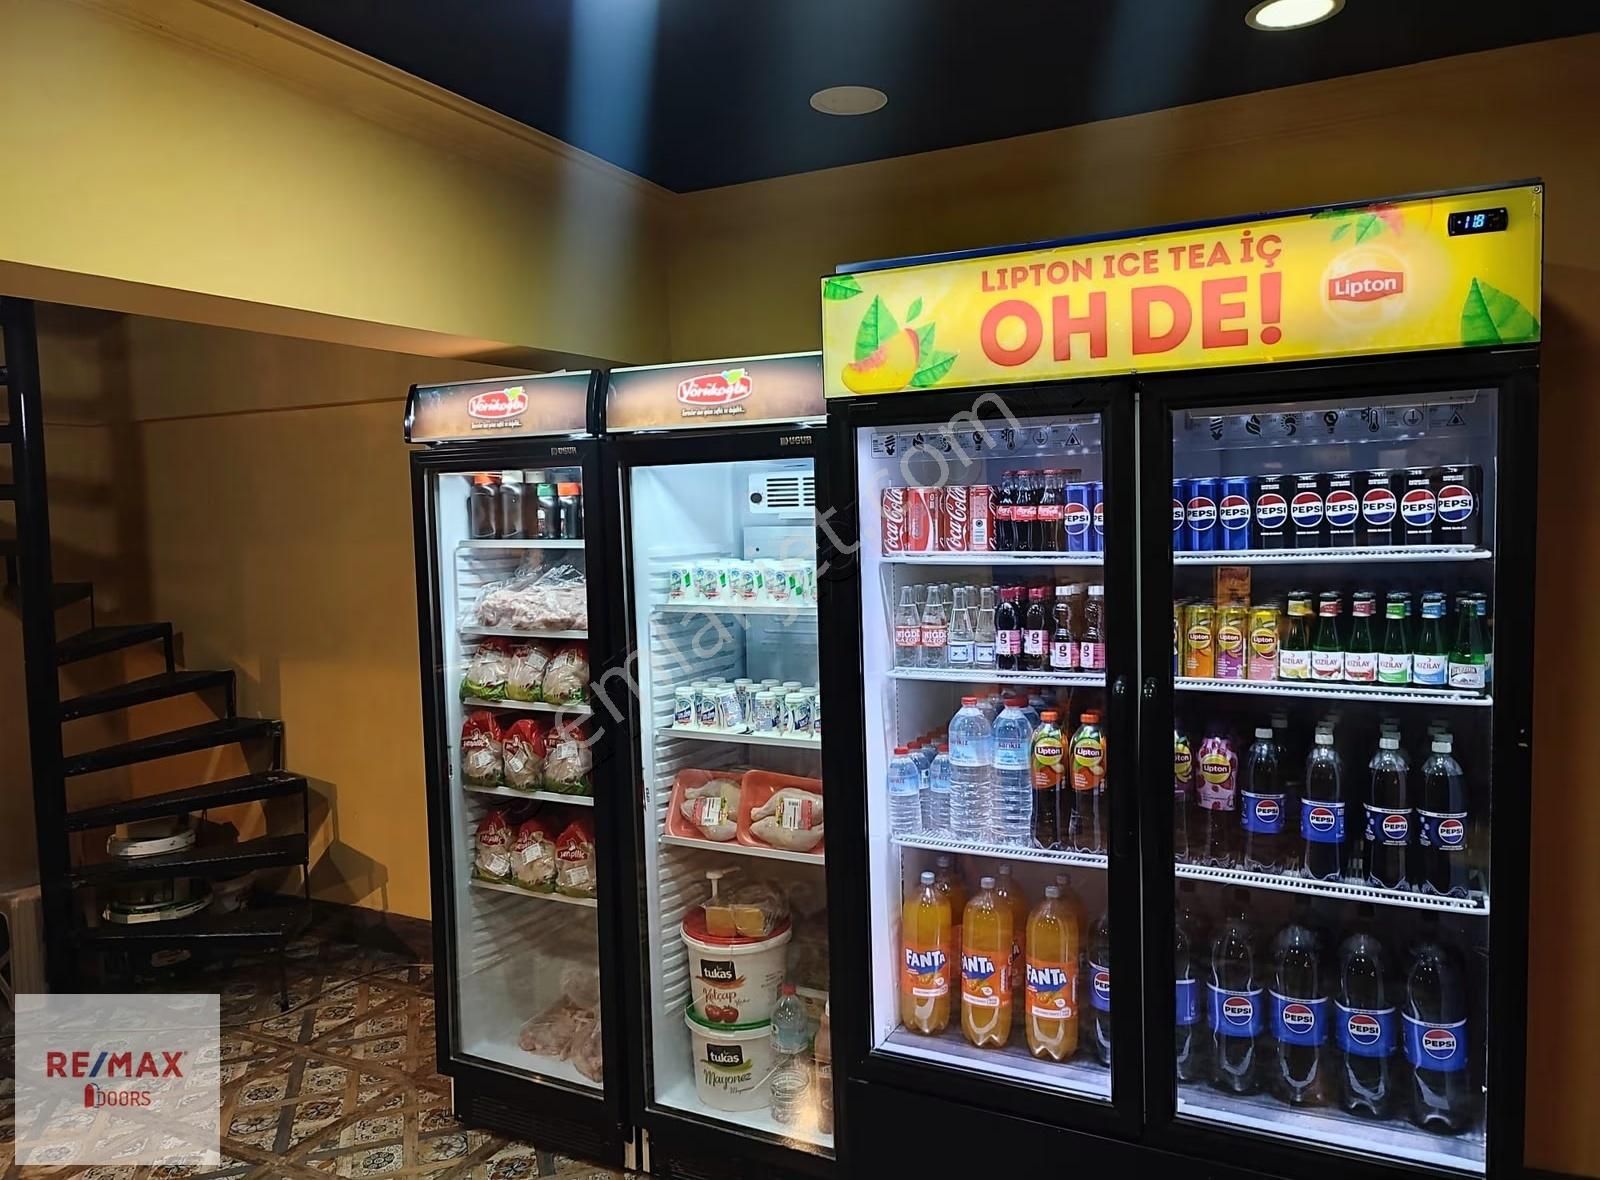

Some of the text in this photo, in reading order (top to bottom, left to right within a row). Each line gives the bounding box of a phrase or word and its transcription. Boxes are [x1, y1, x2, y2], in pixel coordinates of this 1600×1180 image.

[981, 230, 1282, 293] LIPTON ICE TEA İÇ
[1334, 278, 1397, 298] Lipton
[979, 271, 1283, 367] OH DE!
[1326, 503, 1358, 513] PEPSI
[1363, 502, 1396, 512] PEPSI
[1402, 503, 1436, 512] PEPSI
[1438, 499, 1472, 508] PEPSI
[1187, 509, 1216, 518] PEPSI
[1220, 508, 1249, 517] PEPSI
[1256, 506, 1287, 515] PEPSI
[1292, 505, 1323, 514] PEPSI
[1189, 633, 1209, 642] Lipton
[1219, 633, 1239, 642] Lipton
[1253, 636, 1273, 645] Lipton
[1037, 746, 1061, 755] Lipton
[1077, 747, 1100, 757] Lipton
[1203, 764, 1228, 774] Lipton
[1257, 806, 1279, 815] PEPSI
[1310, 815, 1334, 824] PEPSI
[1384, 823, 1408, 831] PEPSI
[1440, 827, 1464, 836] PEPSI
[905, 948, 946, 968] FANTA
[1026, 963, 1067, 986] FANTA
[1224, 1005, 1252, 1015] PEPSI
[1284, 1013, 1313, 1023] PEPSI
[1349, 1023, 1379, 1034] PEPSI
[1424, 1038, 1455, 1048] PEPSI
